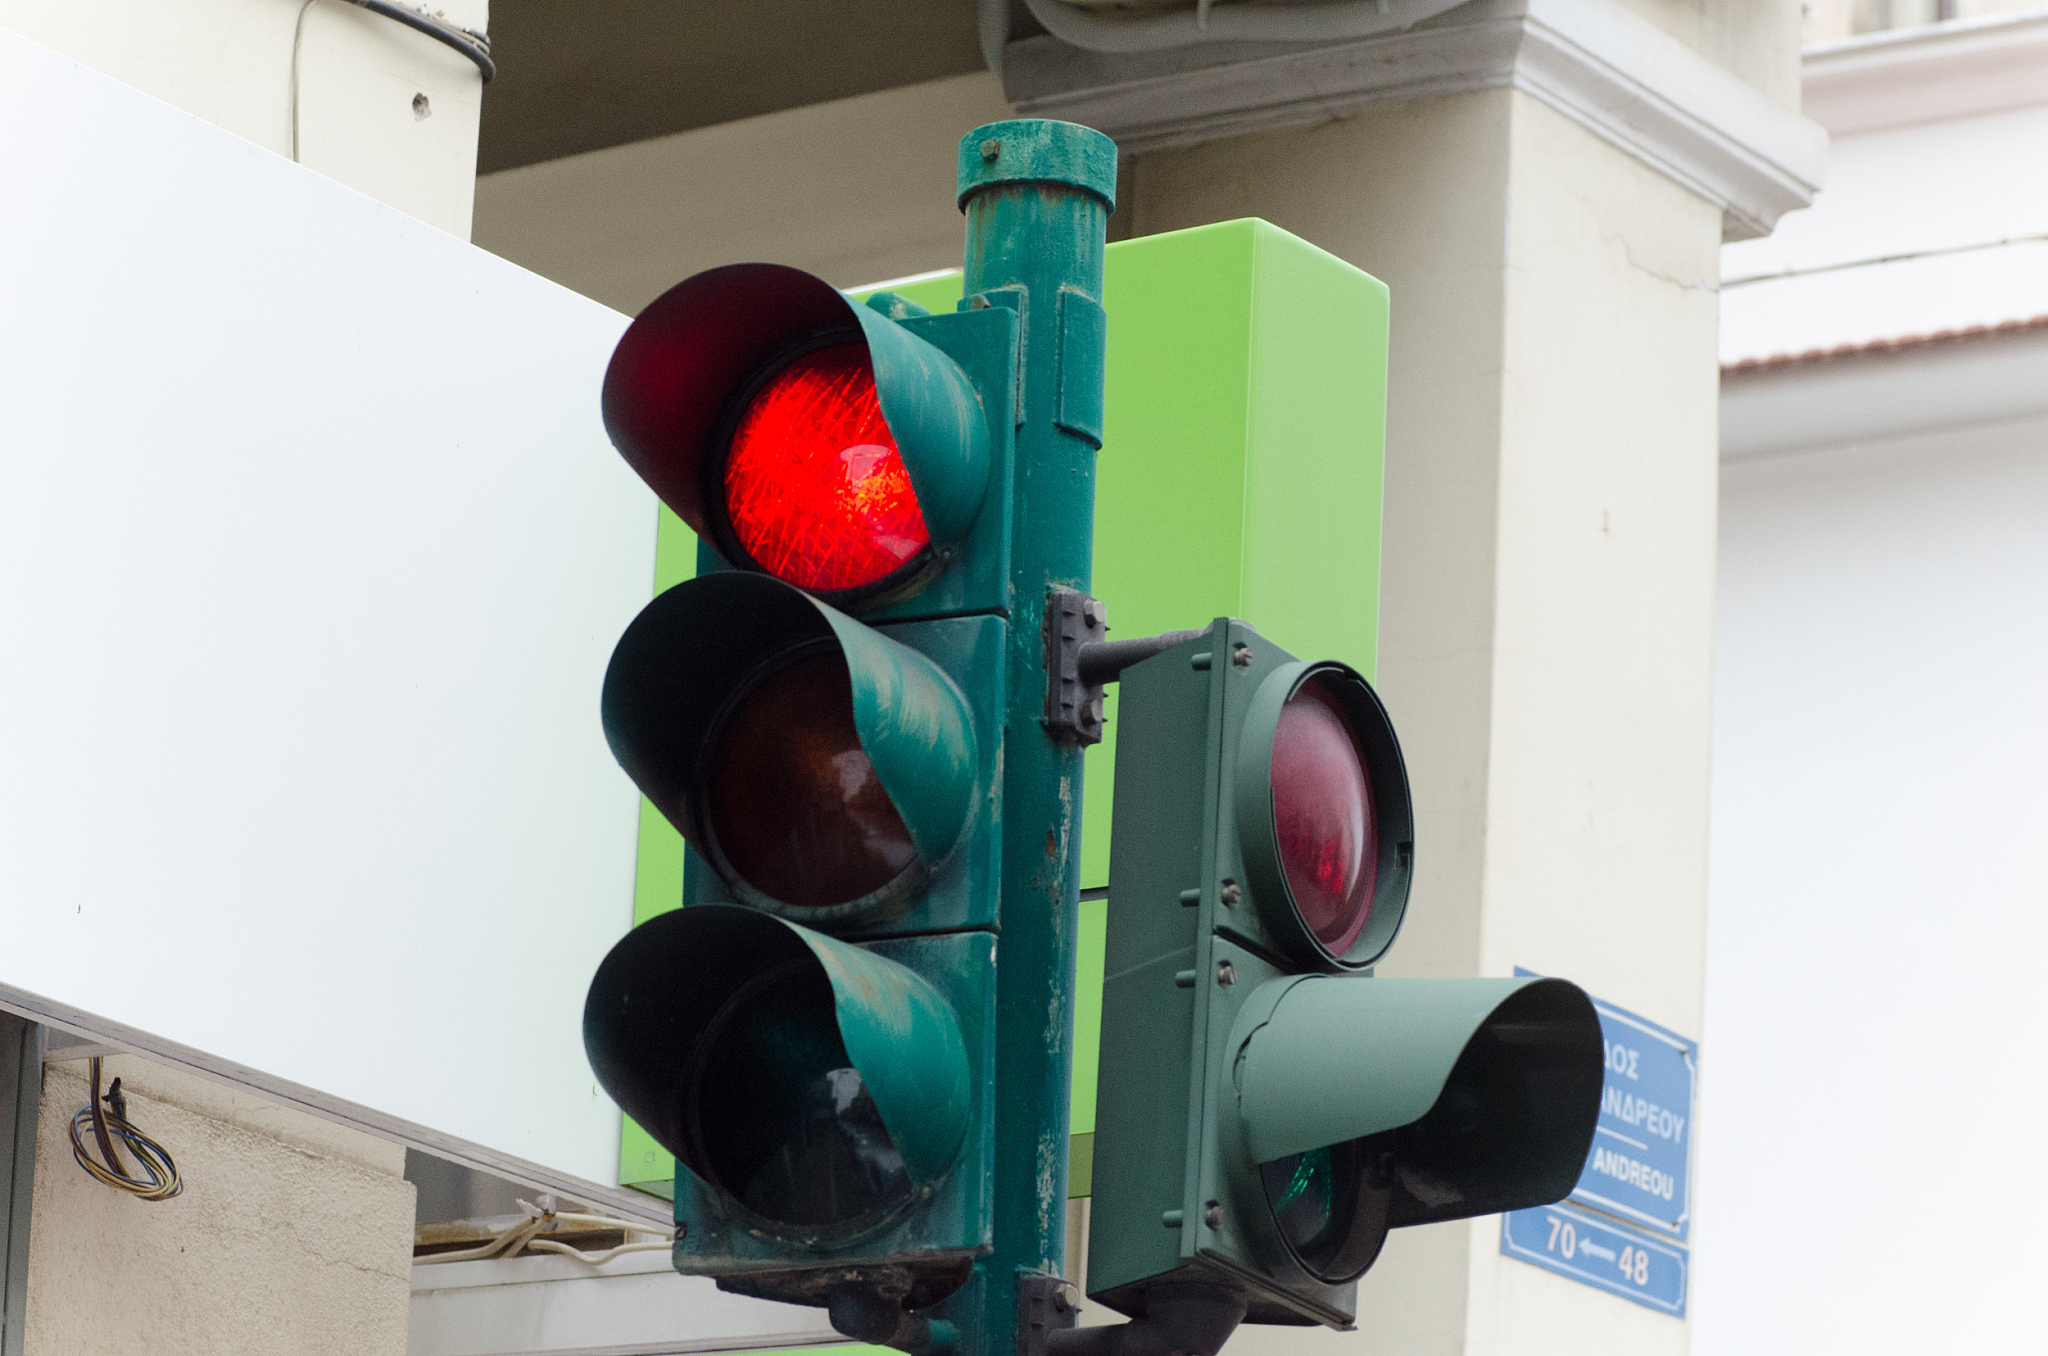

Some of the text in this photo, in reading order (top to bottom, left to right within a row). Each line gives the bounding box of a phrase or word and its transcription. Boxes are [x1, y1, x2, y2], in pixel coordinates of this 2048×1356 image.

[1592, 1146, 1674, 1201] ANDREOU
[1546, 1215, 1649, 1286] 70 48
